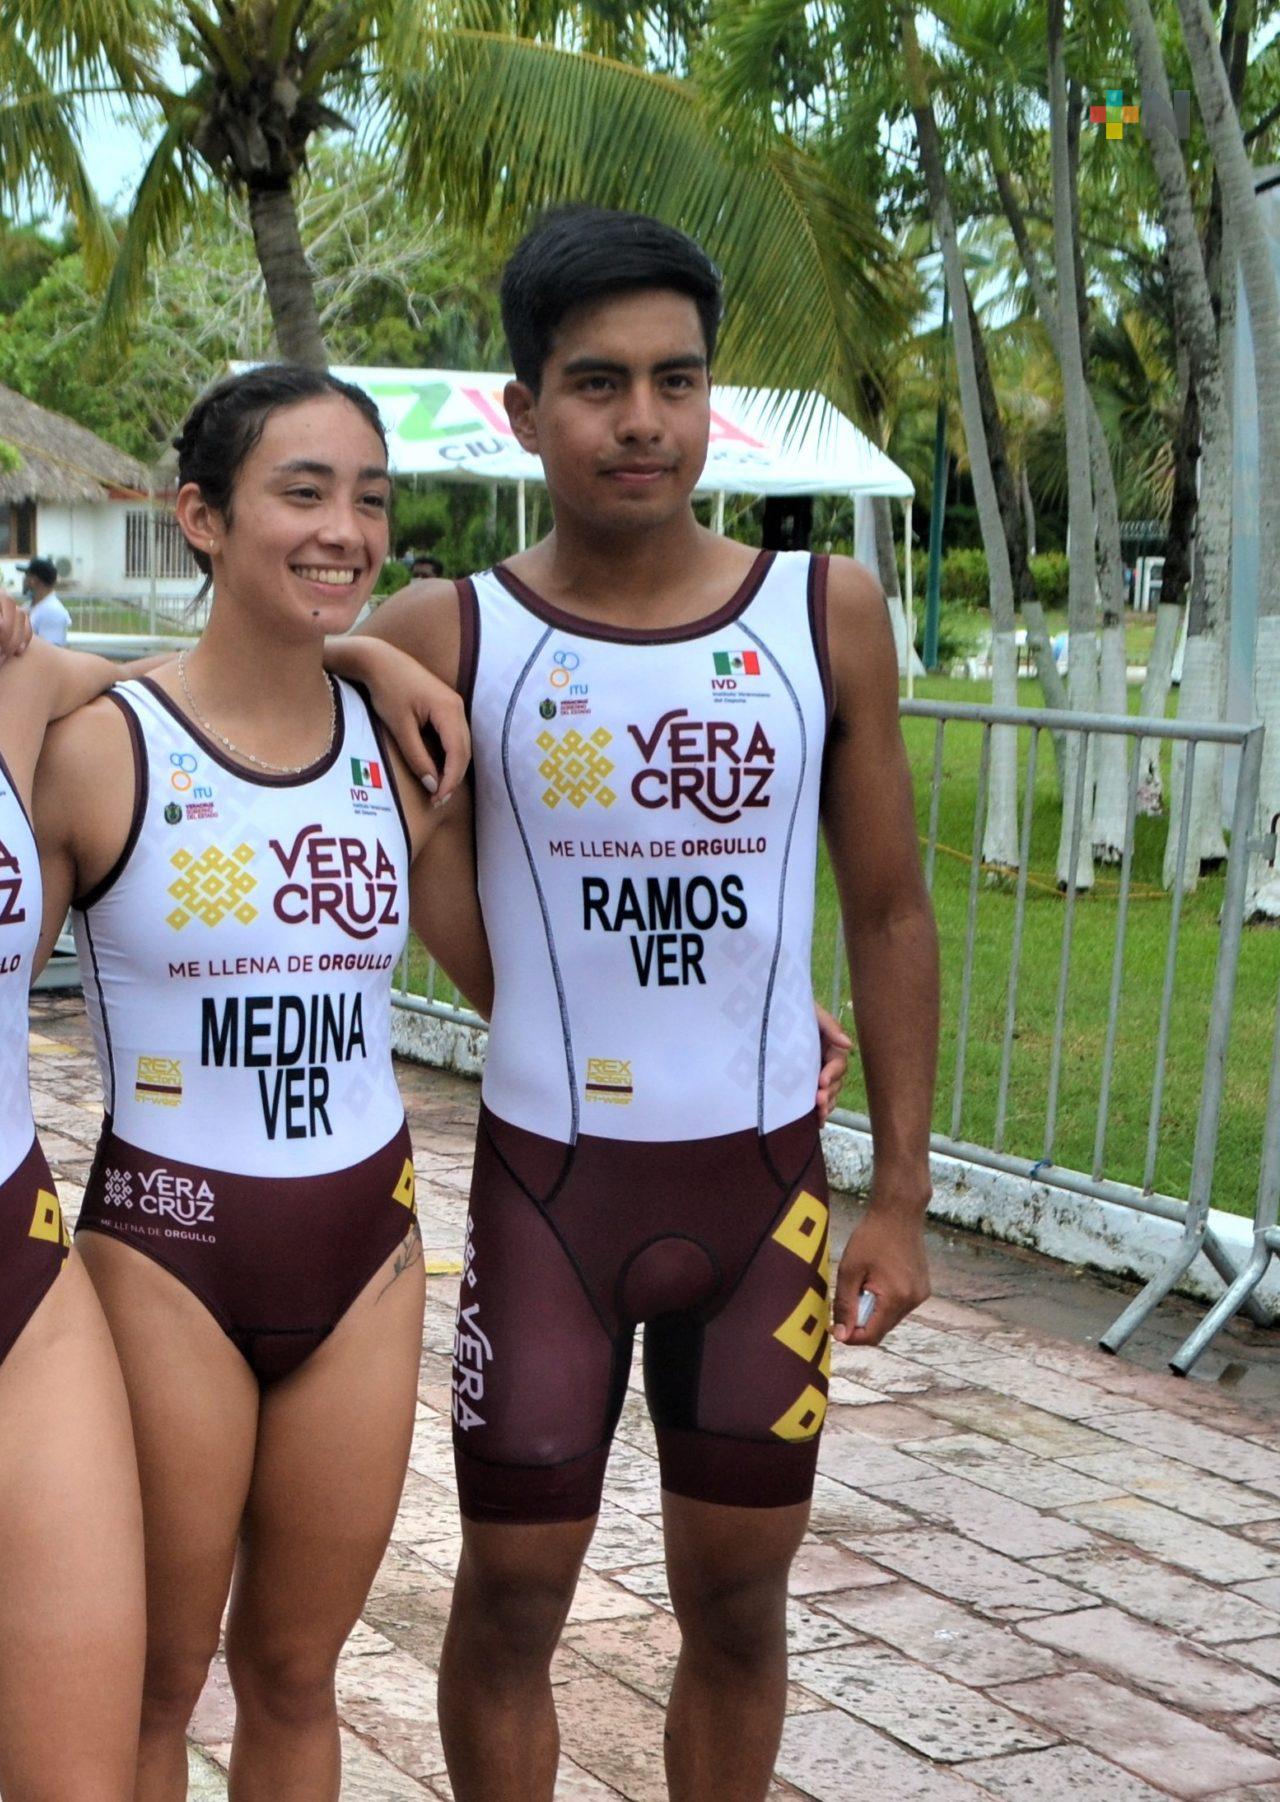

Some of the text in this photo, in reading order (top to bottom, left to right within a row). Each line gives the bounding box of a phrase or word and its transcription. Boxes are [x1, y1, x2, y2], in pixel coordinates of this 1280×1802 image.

[570, 684, 589, 695] ITU
[711, 679, 737, 690] IVD
[627, 708, 776, 764] VERA
[194, 787, 212, 798] ITU
[350, 788, 368, 801] IVD
[631, 766, 776, 824] CRUZ
[269, 824, 397, 880] VERA
[550, 836, 767, 858] ME LLENA DE ORGULLO
[273, 882, 400, 940] CRUZ
[582, 874, 748, 932] RAMOS
[169, 953, 392, 978] ME LLENA DE ORGULLO
[630, 932, 707, 987] VER
[201, 992, 367, 1068] MEDINA
[138, 1056, 181, 1074] REX
[588, 1058, 631, 1073] REX
[258, 1066, 334, 1140] VER
[138, 1168, 215, 1201] VERA
[140, 1194, 215, 1226] CRUZ
[148, 1226, 161, 1236] DE
[164, 1229, 216, 1243] ORGULLO
[459, 1303, 493, 1431] VERA
